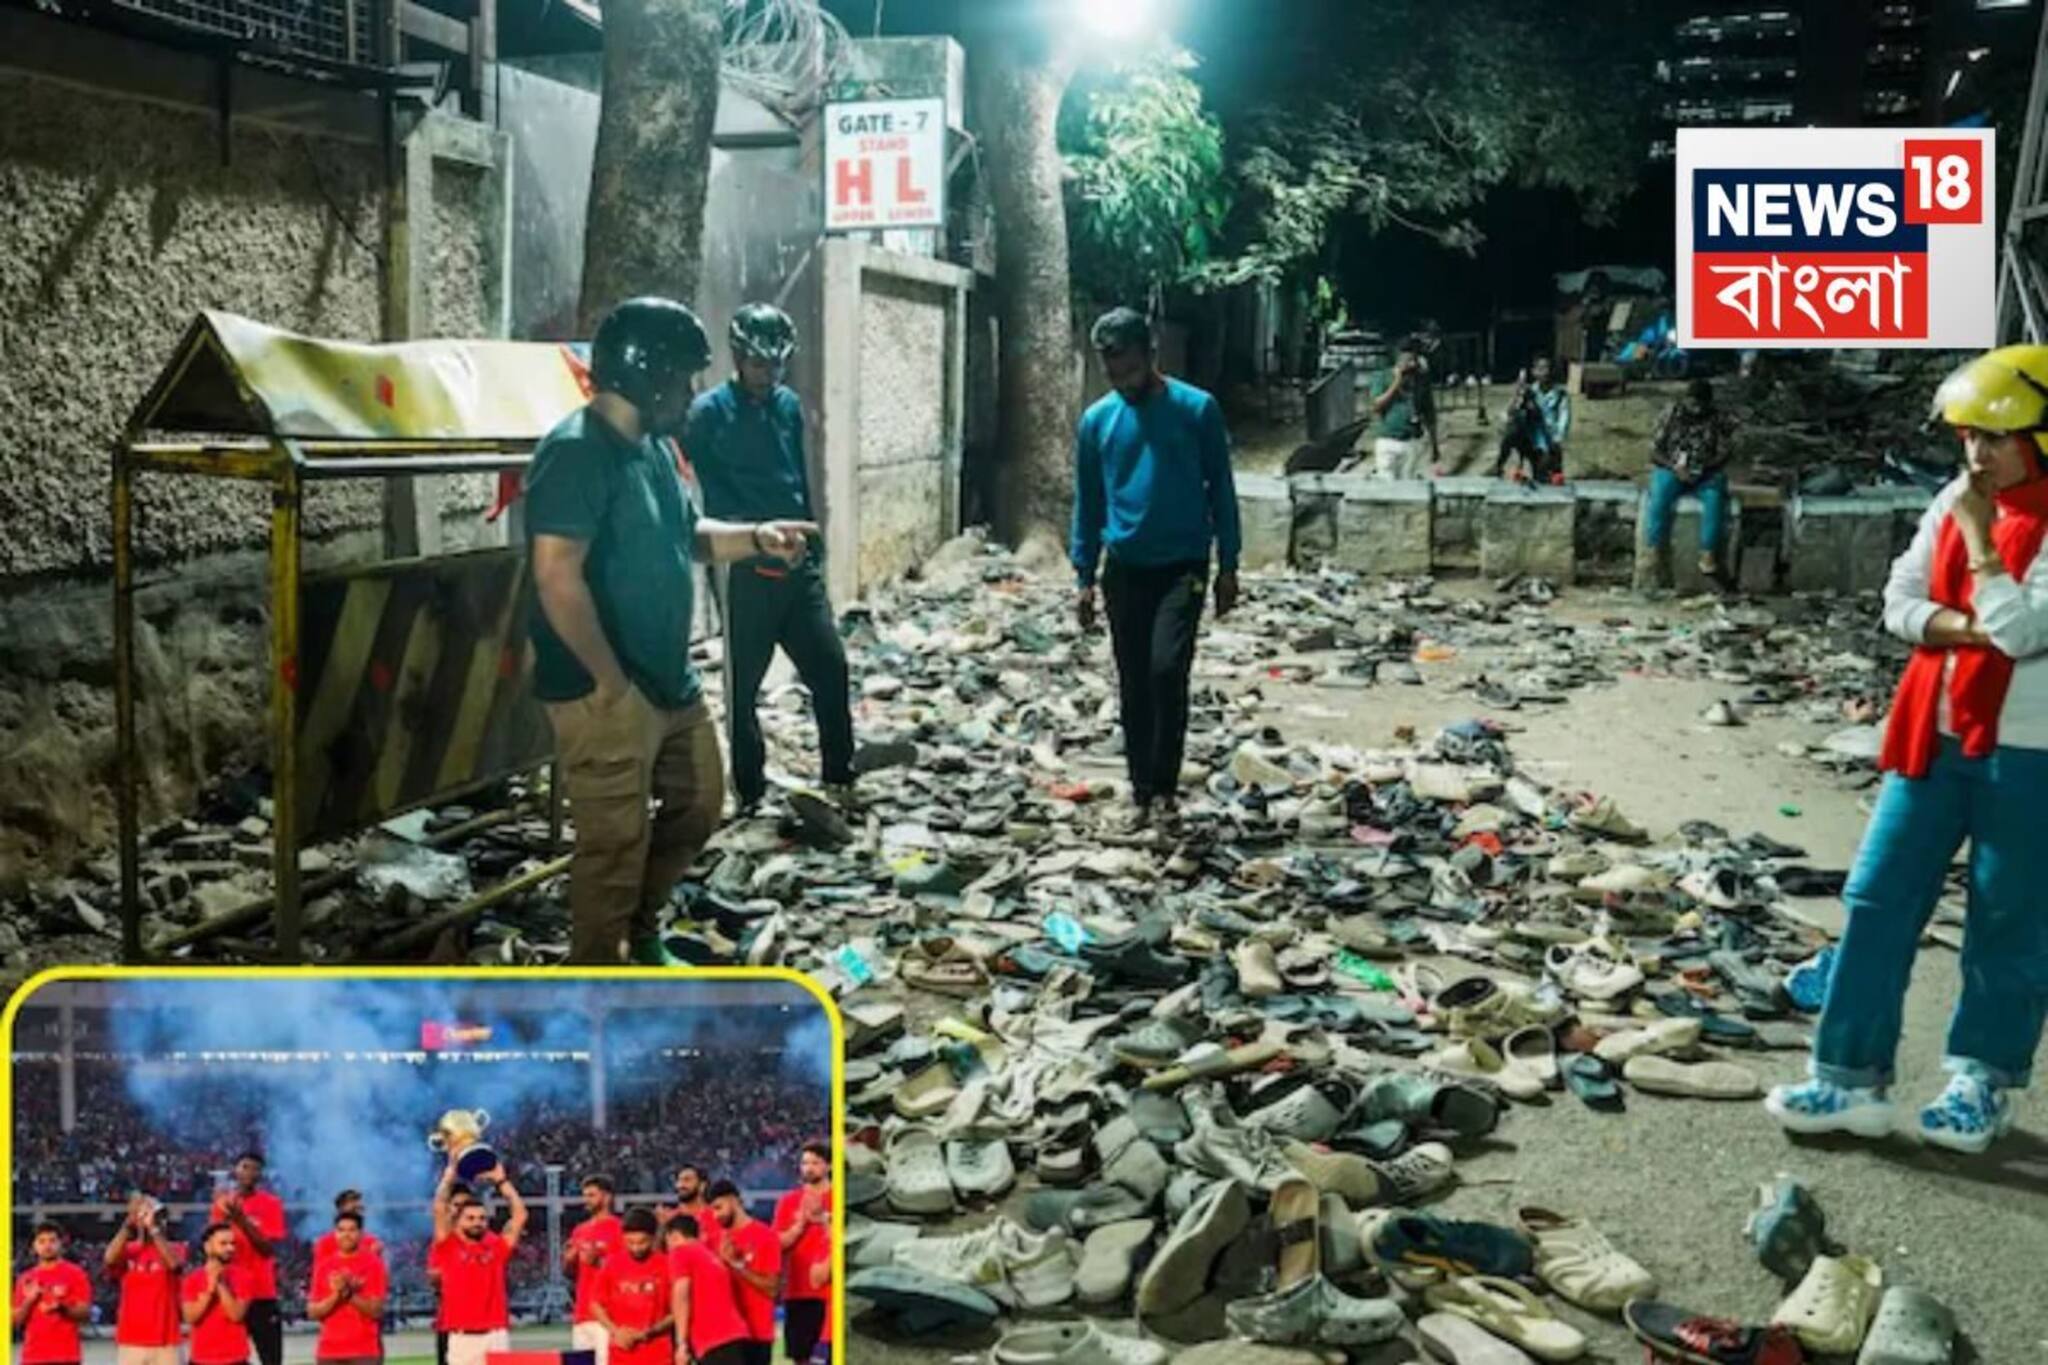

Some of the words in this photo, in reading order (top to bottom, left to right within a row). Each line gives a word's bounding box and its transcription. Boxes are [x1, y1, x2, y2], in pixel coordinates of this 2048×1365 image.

[838, 114, 894, 134] GATE
[915, 112, 929, 130] 7
[836, 159, 871, 205] H
[897, 157, 927, 203] L
